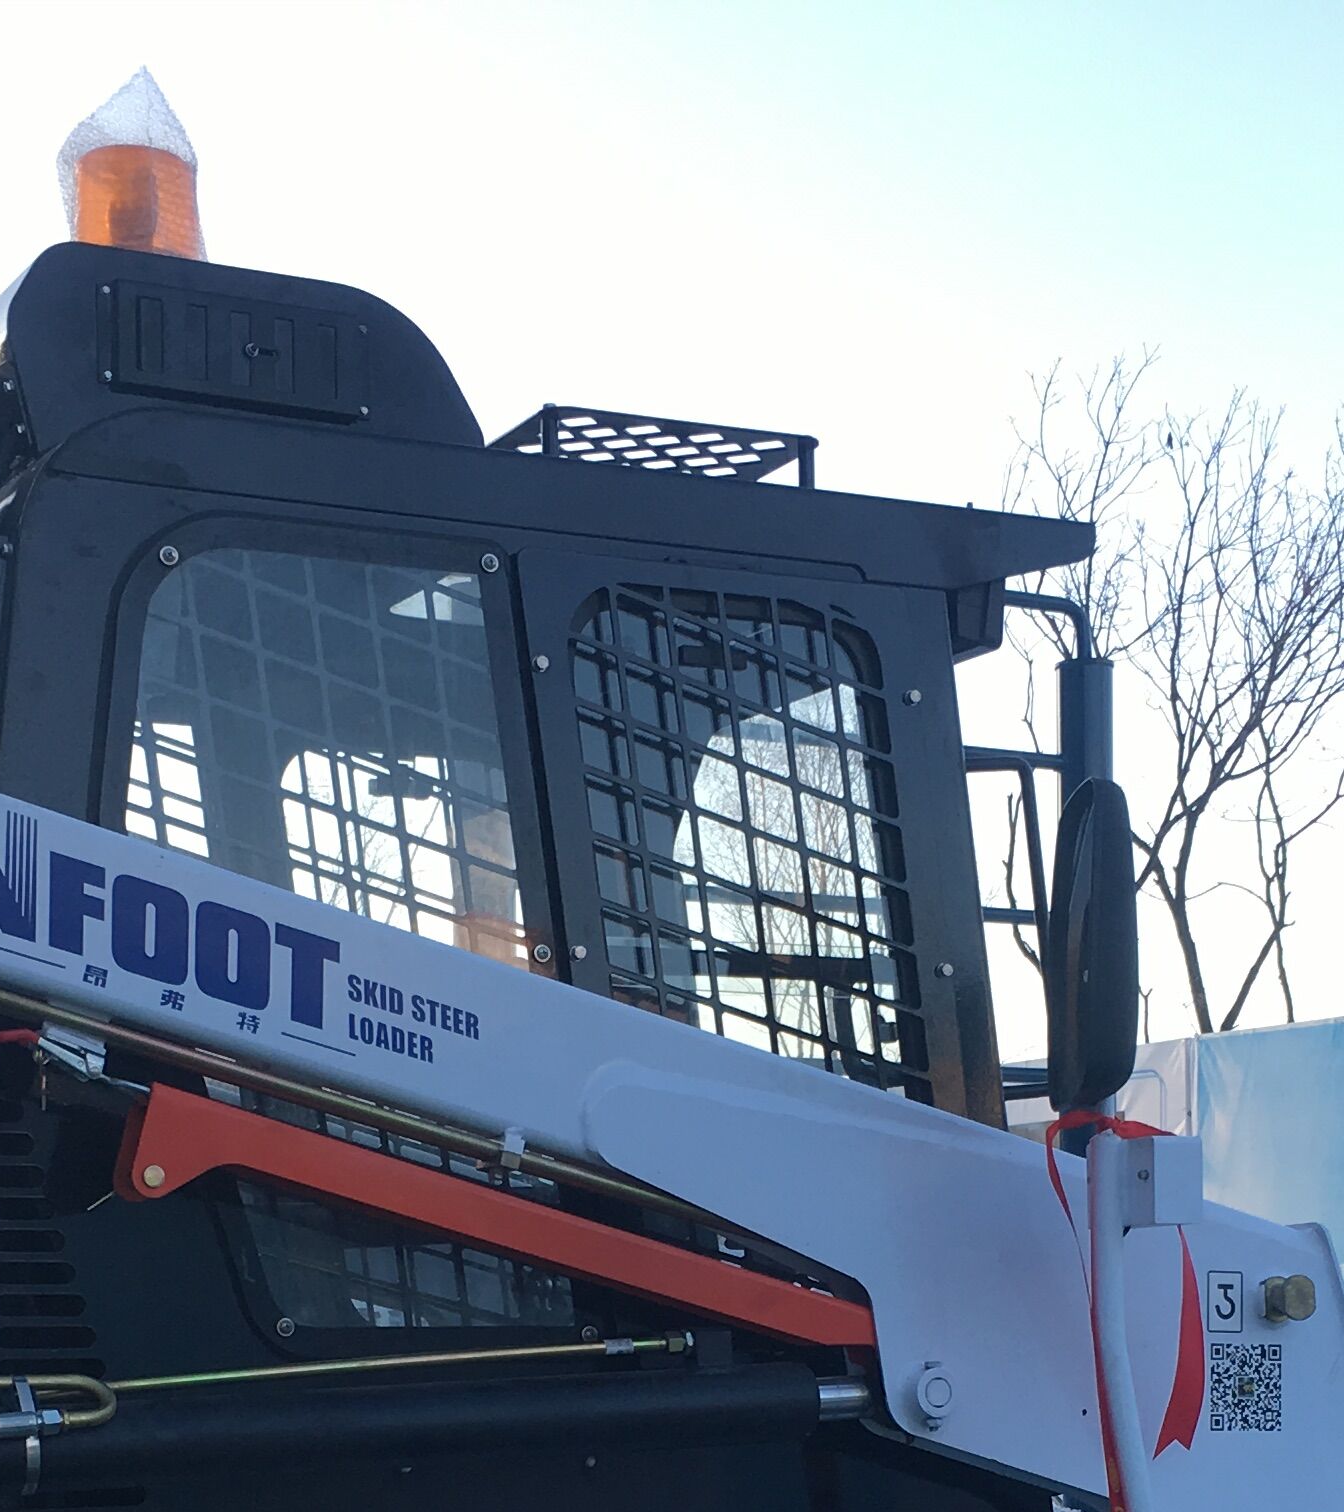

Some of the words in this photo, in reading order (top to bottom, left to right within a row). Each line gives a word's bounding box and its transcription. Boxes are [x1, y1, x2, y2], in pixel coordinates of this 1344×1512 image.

[347, 974, 404, 1016] SKID
[411, 994, 479, 1040] STEER
[348, 1013, 433, 1064] LOADER
